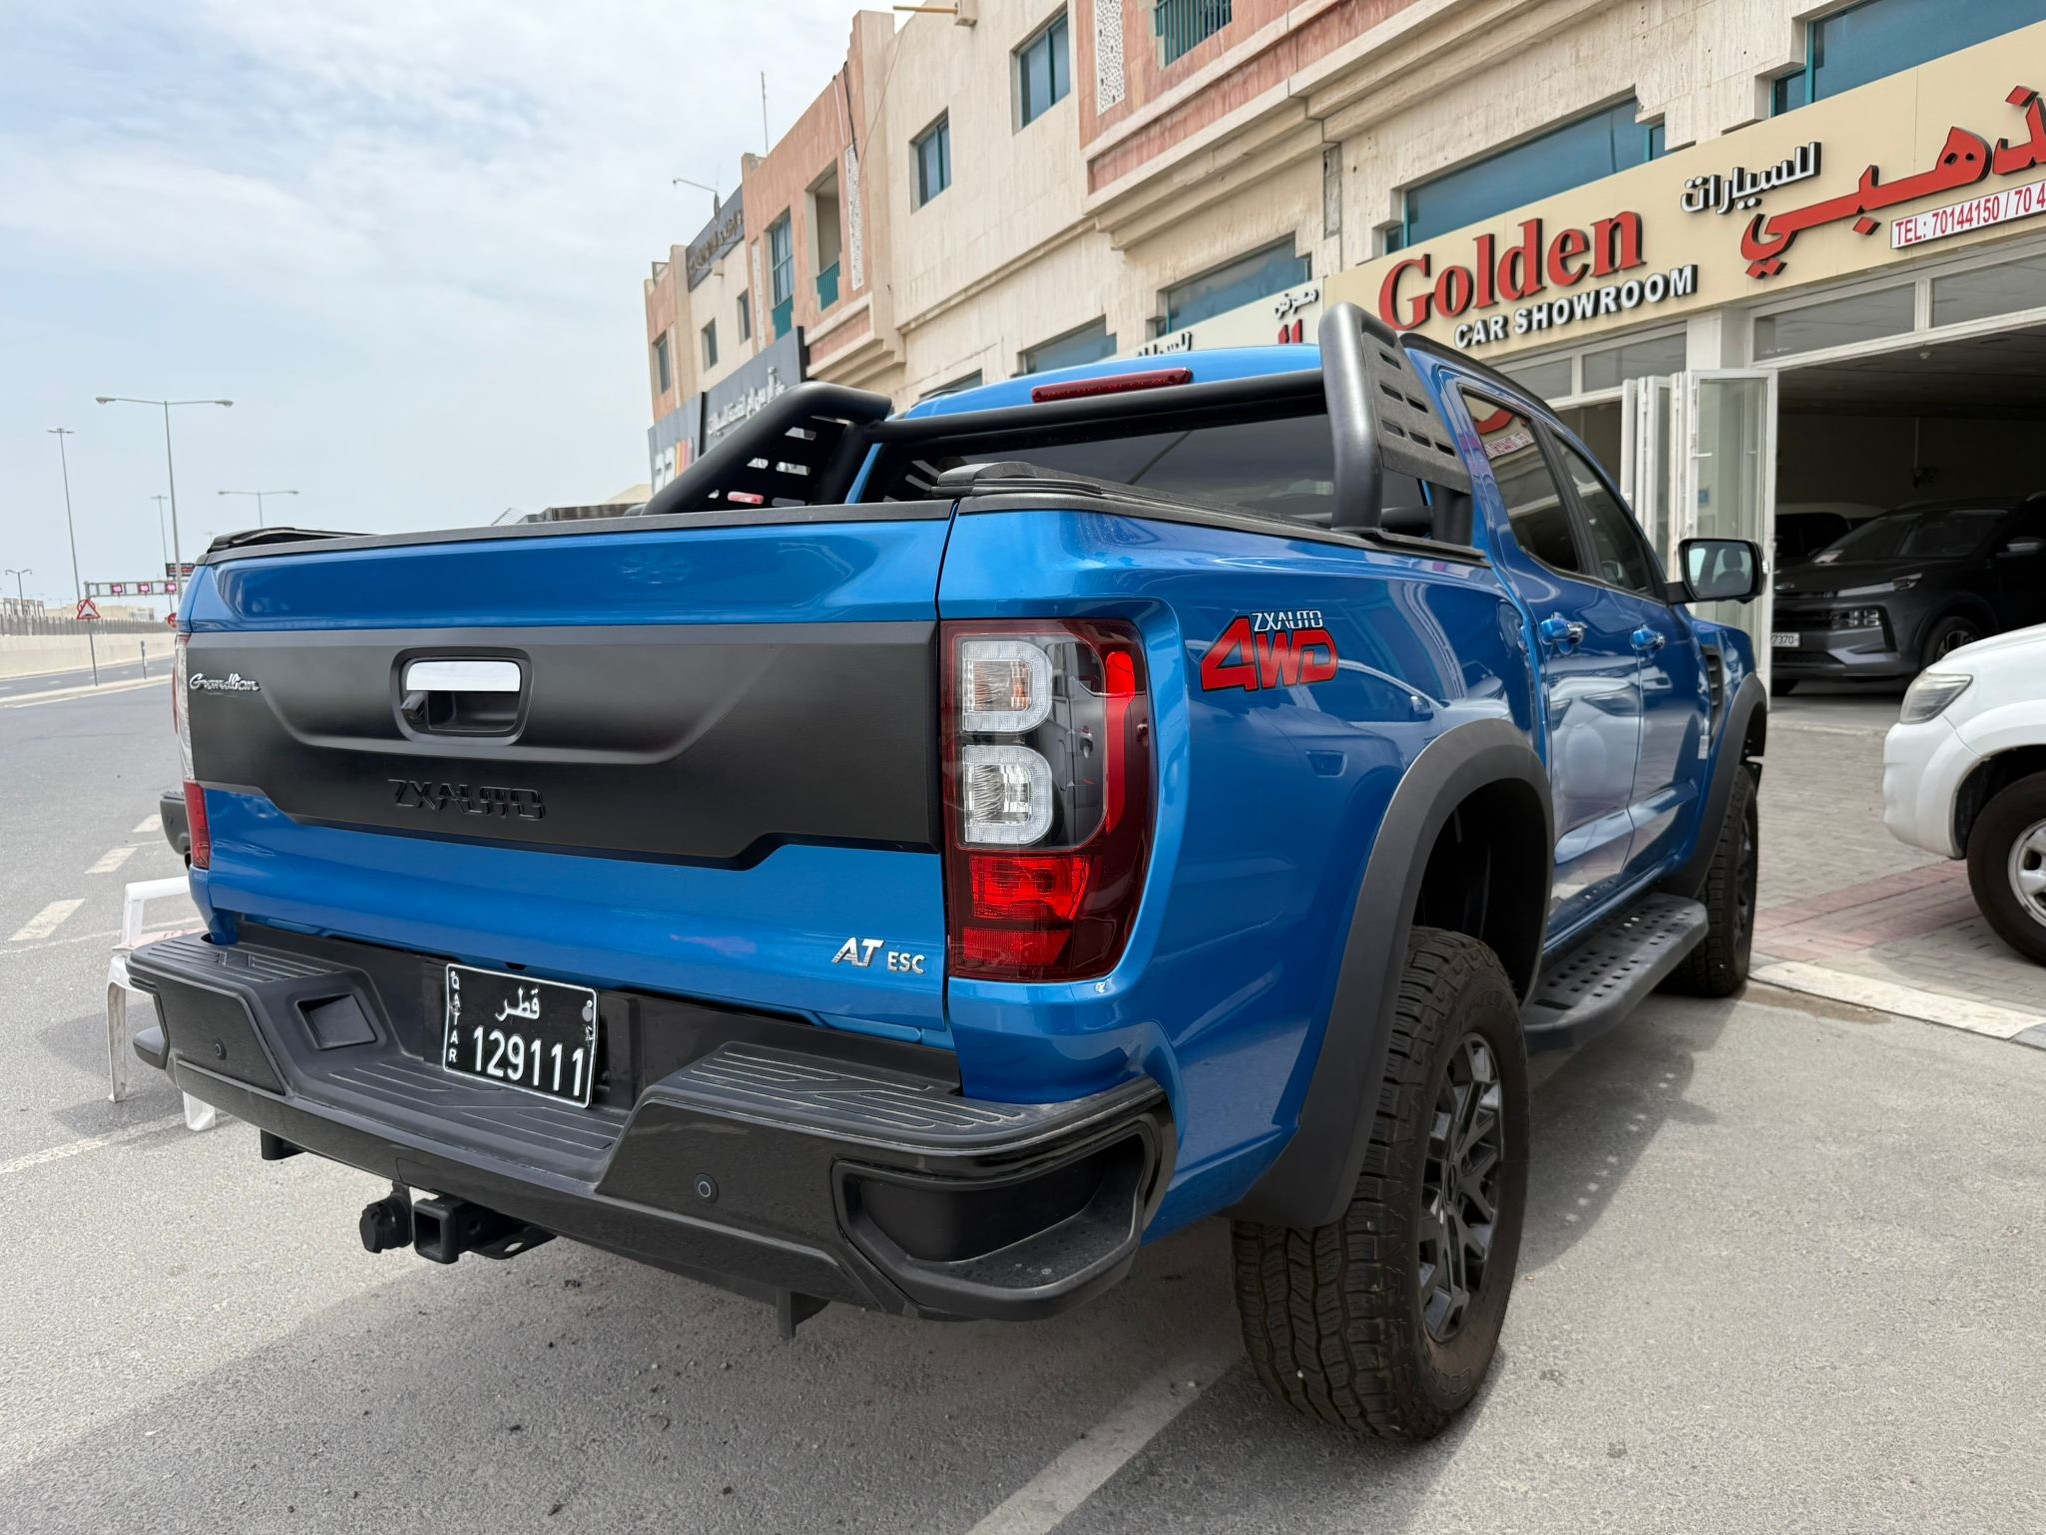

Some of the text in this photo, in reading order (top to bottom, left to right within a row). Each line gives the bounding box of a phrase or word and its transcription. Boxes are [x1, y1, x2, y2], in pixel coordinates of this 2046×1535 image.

[1680, 141, 1822, 215] للسيارات
[1895, 217, 1926, 245] TEL:
[1932, 196, 2000, 237] 70144150
[2014, 187, 2032, 216] 70
[1378, 211, 1647, 331] Golden
[1455, 264, 1698, 349] CAR SHOWROOM
[1201, 615, 1338, 692] 4WD
[1252, 610, 1323, 632] ZXAUTO
[387, 778, 545, 821] ZXAUTO
[831, 936, 926, 975] AT ESC
[495, 985, 540, 1022] قطر
[473, 1025, 585, 1097] 129111
